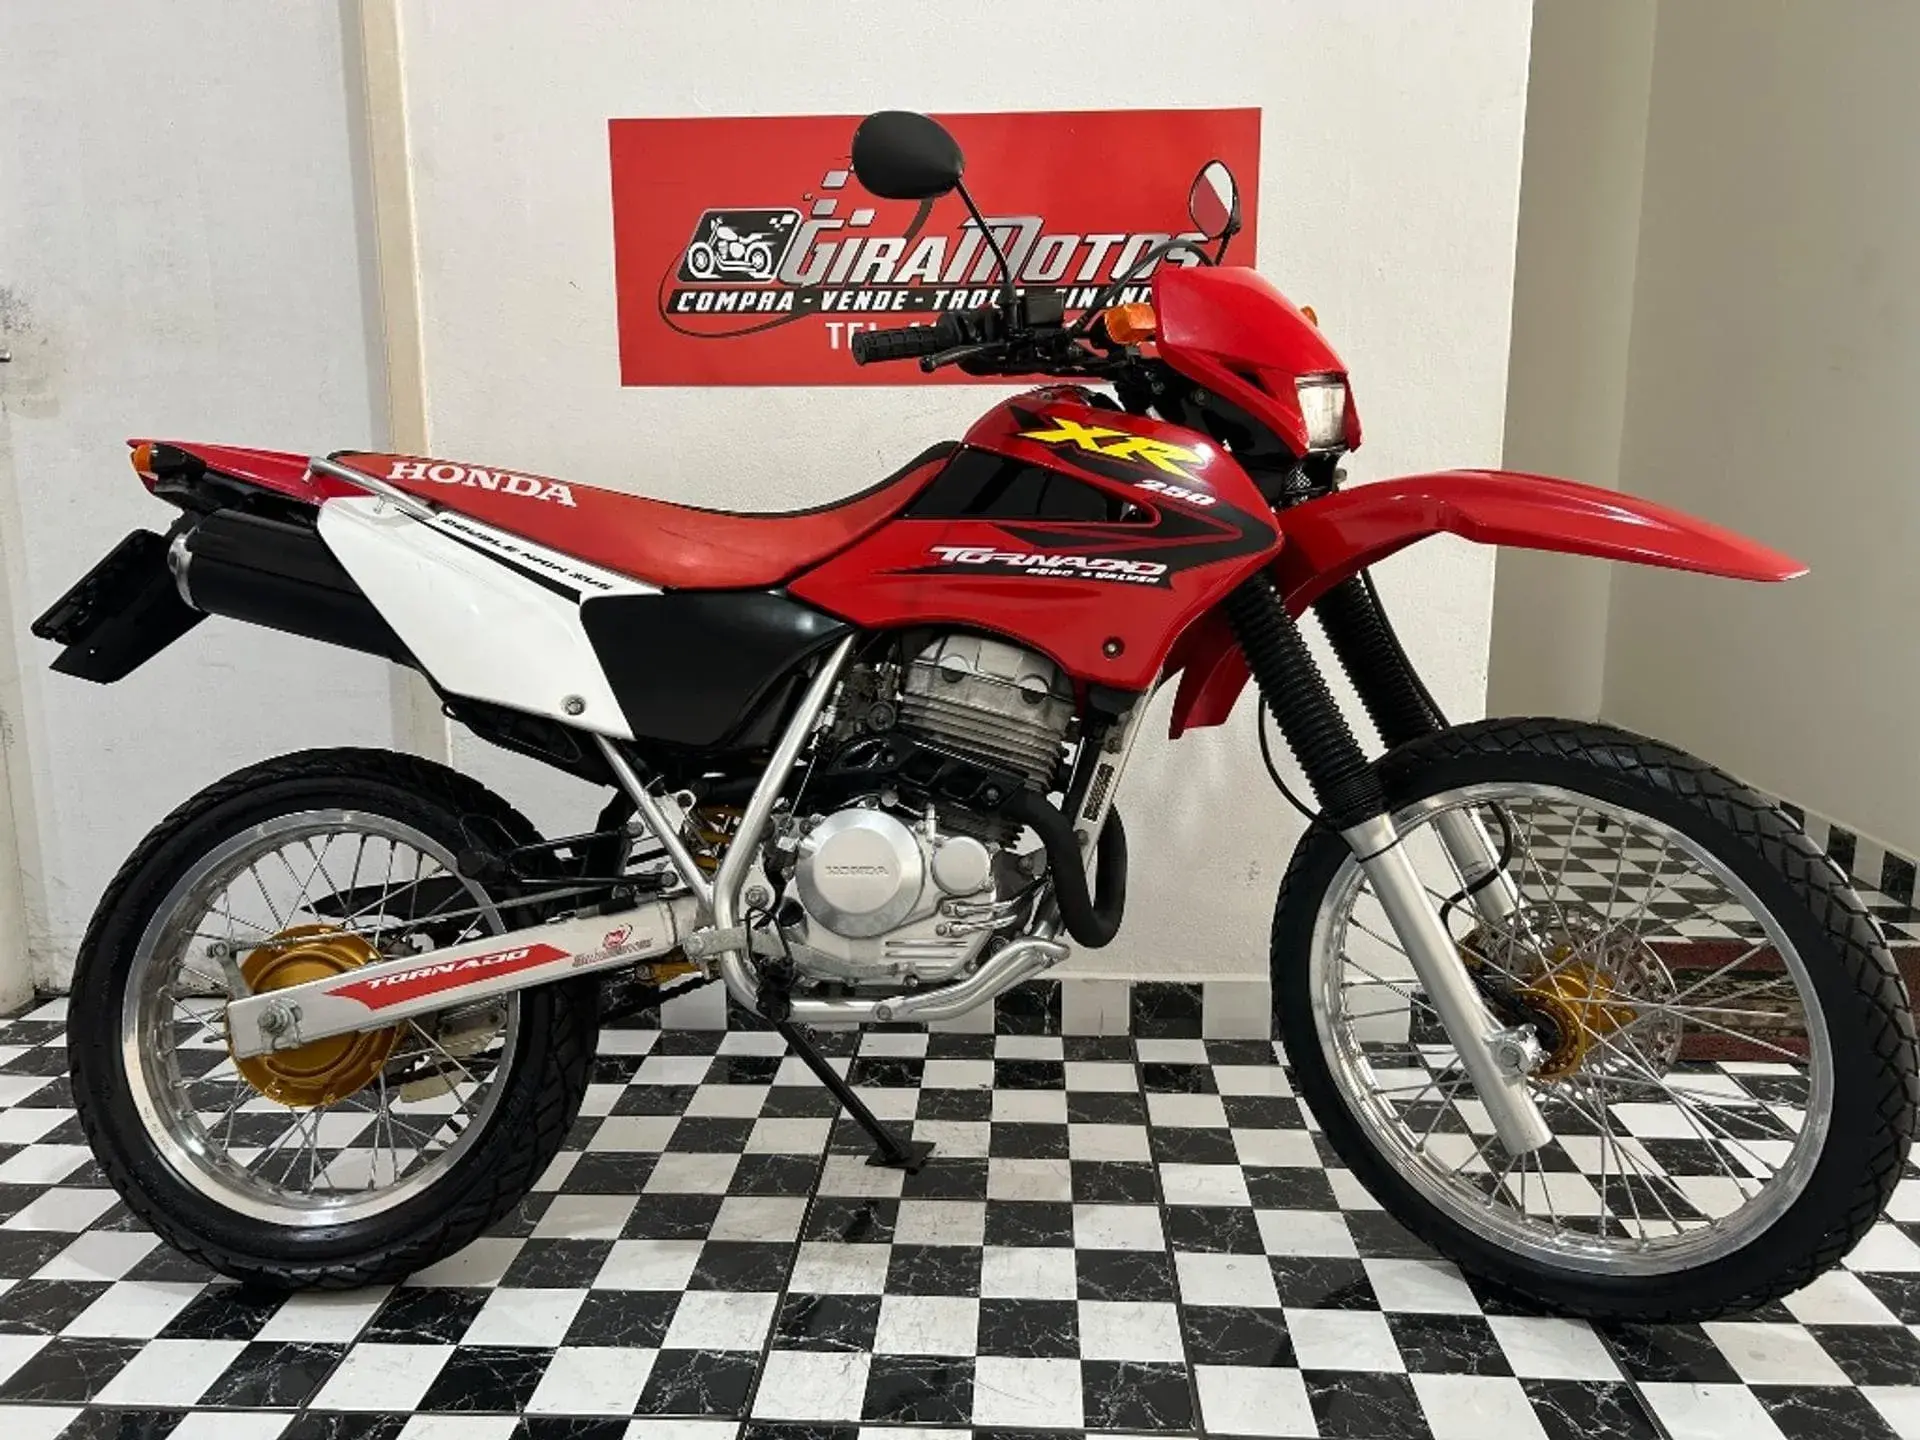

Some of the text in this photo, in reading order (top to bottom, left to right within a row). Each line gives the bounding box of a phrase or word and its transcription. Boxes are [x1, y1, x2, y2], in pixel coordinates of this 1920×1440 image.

[676, 291, 794, 312] COMPRA
[820, 291, 909, 311] VENDE
[1016, 416, 1206, 483] XR
[386, 461, 577, 508] HONDA
[1133, 479, 1217, 506] 250
[930, 546, 1168, 575] TORNADO
[367, 949, 531, 989] TORNADO
